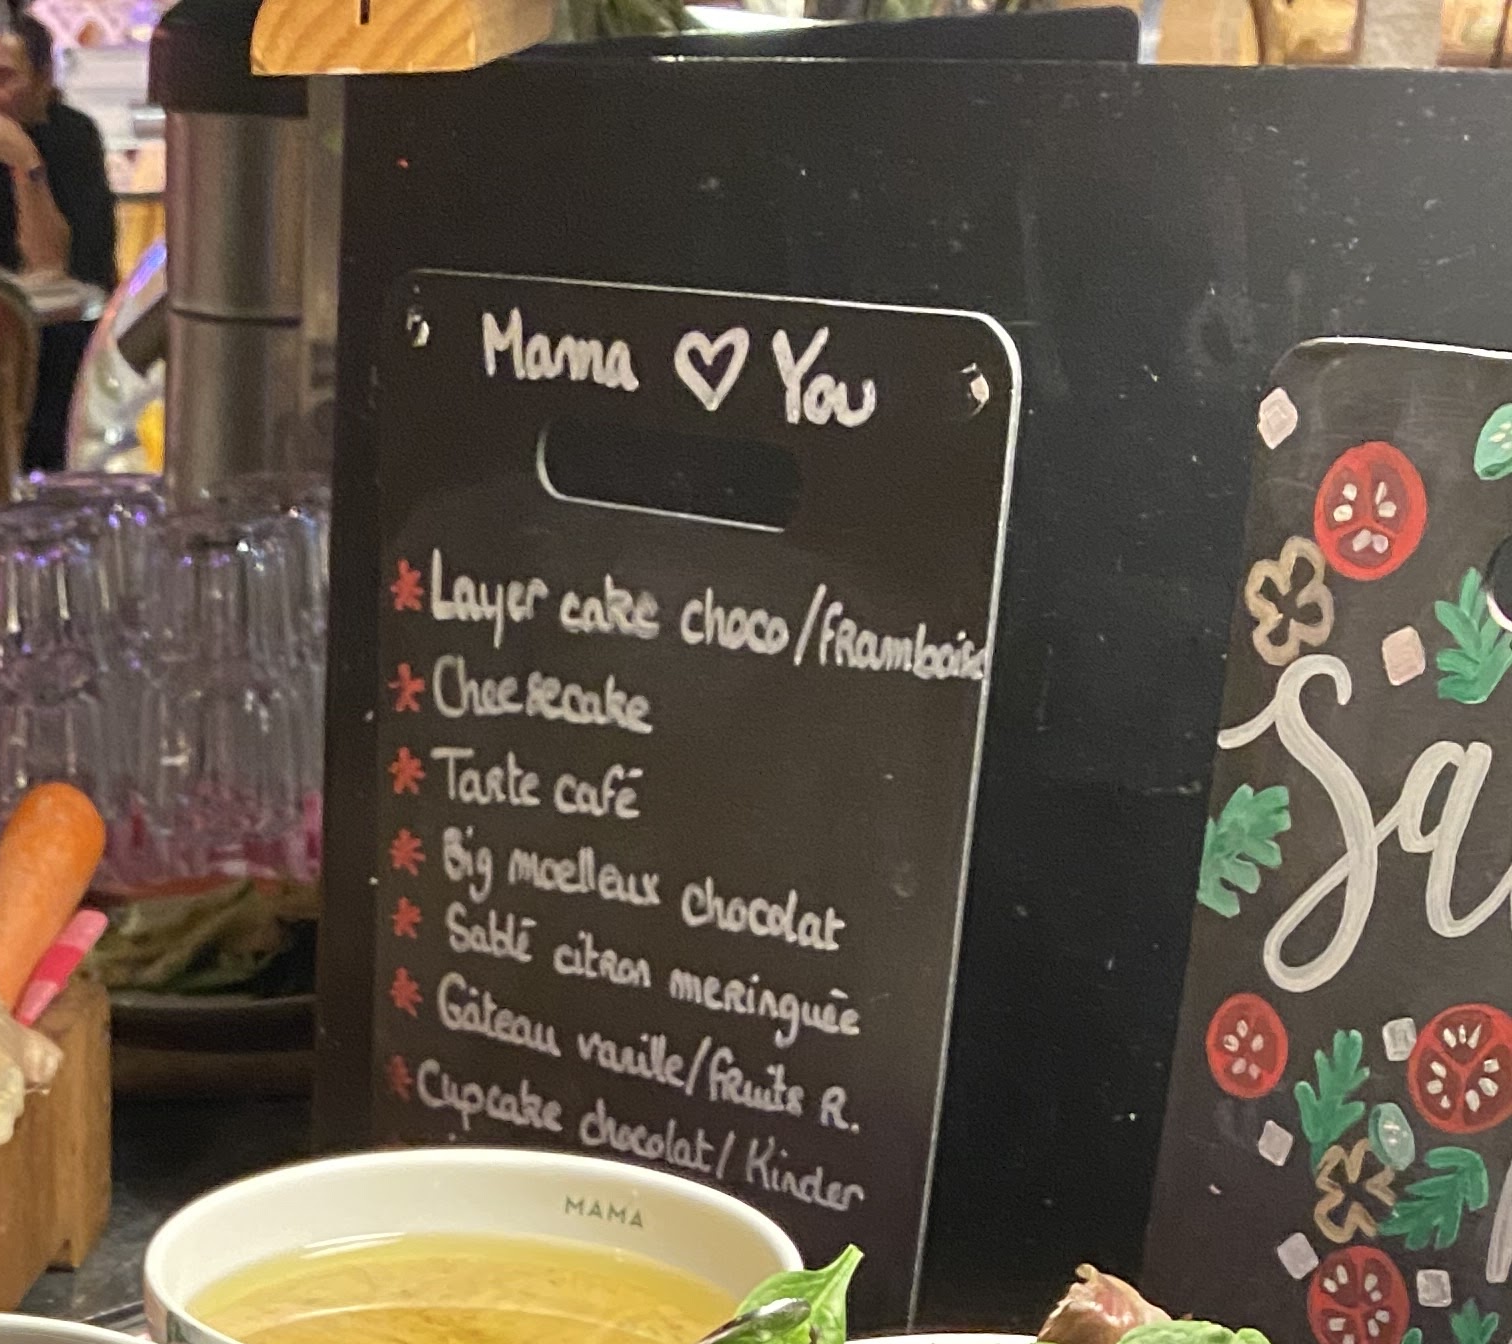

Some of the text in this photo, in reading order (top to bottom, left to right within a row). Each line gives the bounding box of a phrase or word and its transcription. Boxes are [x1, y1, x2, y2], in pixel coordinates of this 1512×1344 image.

[482, 307, 877, 428] Mama You
[431, 547, 548, 649] Layer
[560, 573, 659, 639] cake
[432, 655, 653, 734] Cheesecake
[554, 763, 643, 818] café
[1217, 654, 1512, 993] Sa
[443, 826, 493, 904] Big
[508, 846, 660, 906] moelleux
[417, 1058, 563, 1132] Cupcake
[820, 1086, 860, 1134] R.
[564, 1196, 643, 1228] MAMA
